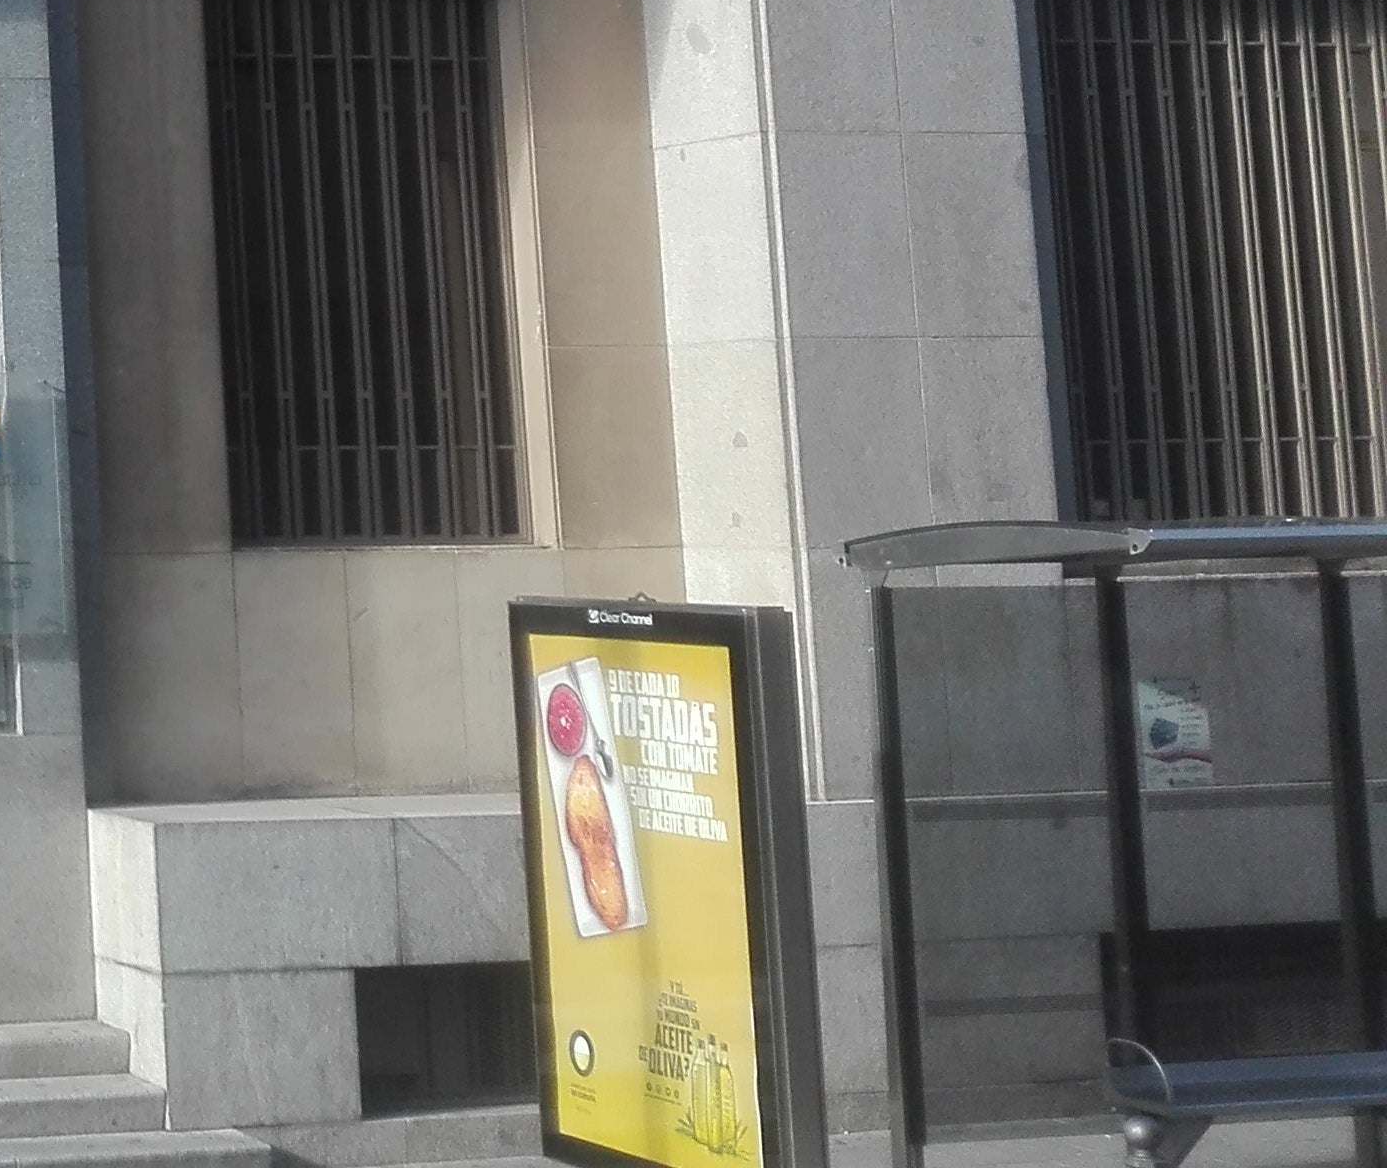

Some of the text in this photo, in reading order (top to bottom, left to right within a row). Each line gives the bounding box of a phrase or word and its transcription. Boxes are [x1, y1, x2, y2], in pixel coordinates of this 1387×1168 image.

[599, 611, 653, 626] Clear Channel
[609, 669, 680, 699] 9 DE CADA 10
[610, 693, 718, 747] TOSTADAS
[641, 739, 718, 776] CON TOMATE
[638, 767, 649, 786] SE
[649, 788, 662, 809] UN
[639, 808, 729, 842] DE ACEITE DE OLIVA
[665, 1010, 690, 1028] MUNDO
[656, 1023, 693, 1055] ACEITE
[639, 1045, 690, 1082] DE OLIVA?
